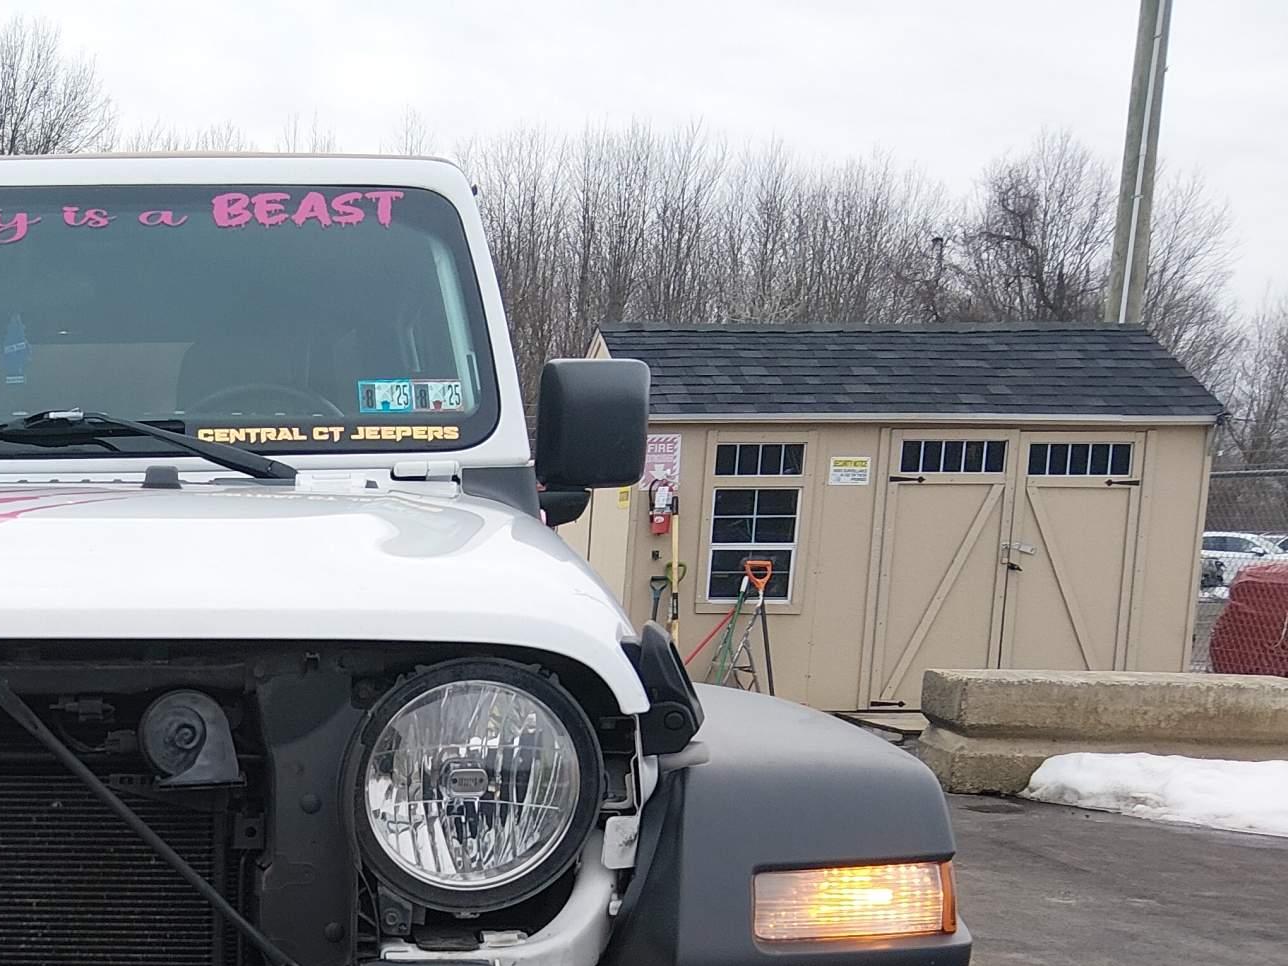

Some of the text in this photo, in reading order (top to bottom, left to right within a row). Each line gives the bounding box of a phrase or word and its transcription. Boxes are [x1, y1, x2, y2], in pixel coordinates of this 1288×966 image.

[62, 206, 116, 228] is
[137, 209, 189, 228] a
[212, 191, 404, 230] BEAST
[395, 384, 410, 406] 25
[447, 384, 462, 406] 25
[198, 426, 460, 444] CENTRAL CT JEEPERS
[647, 443, 674, 454] FIRE
